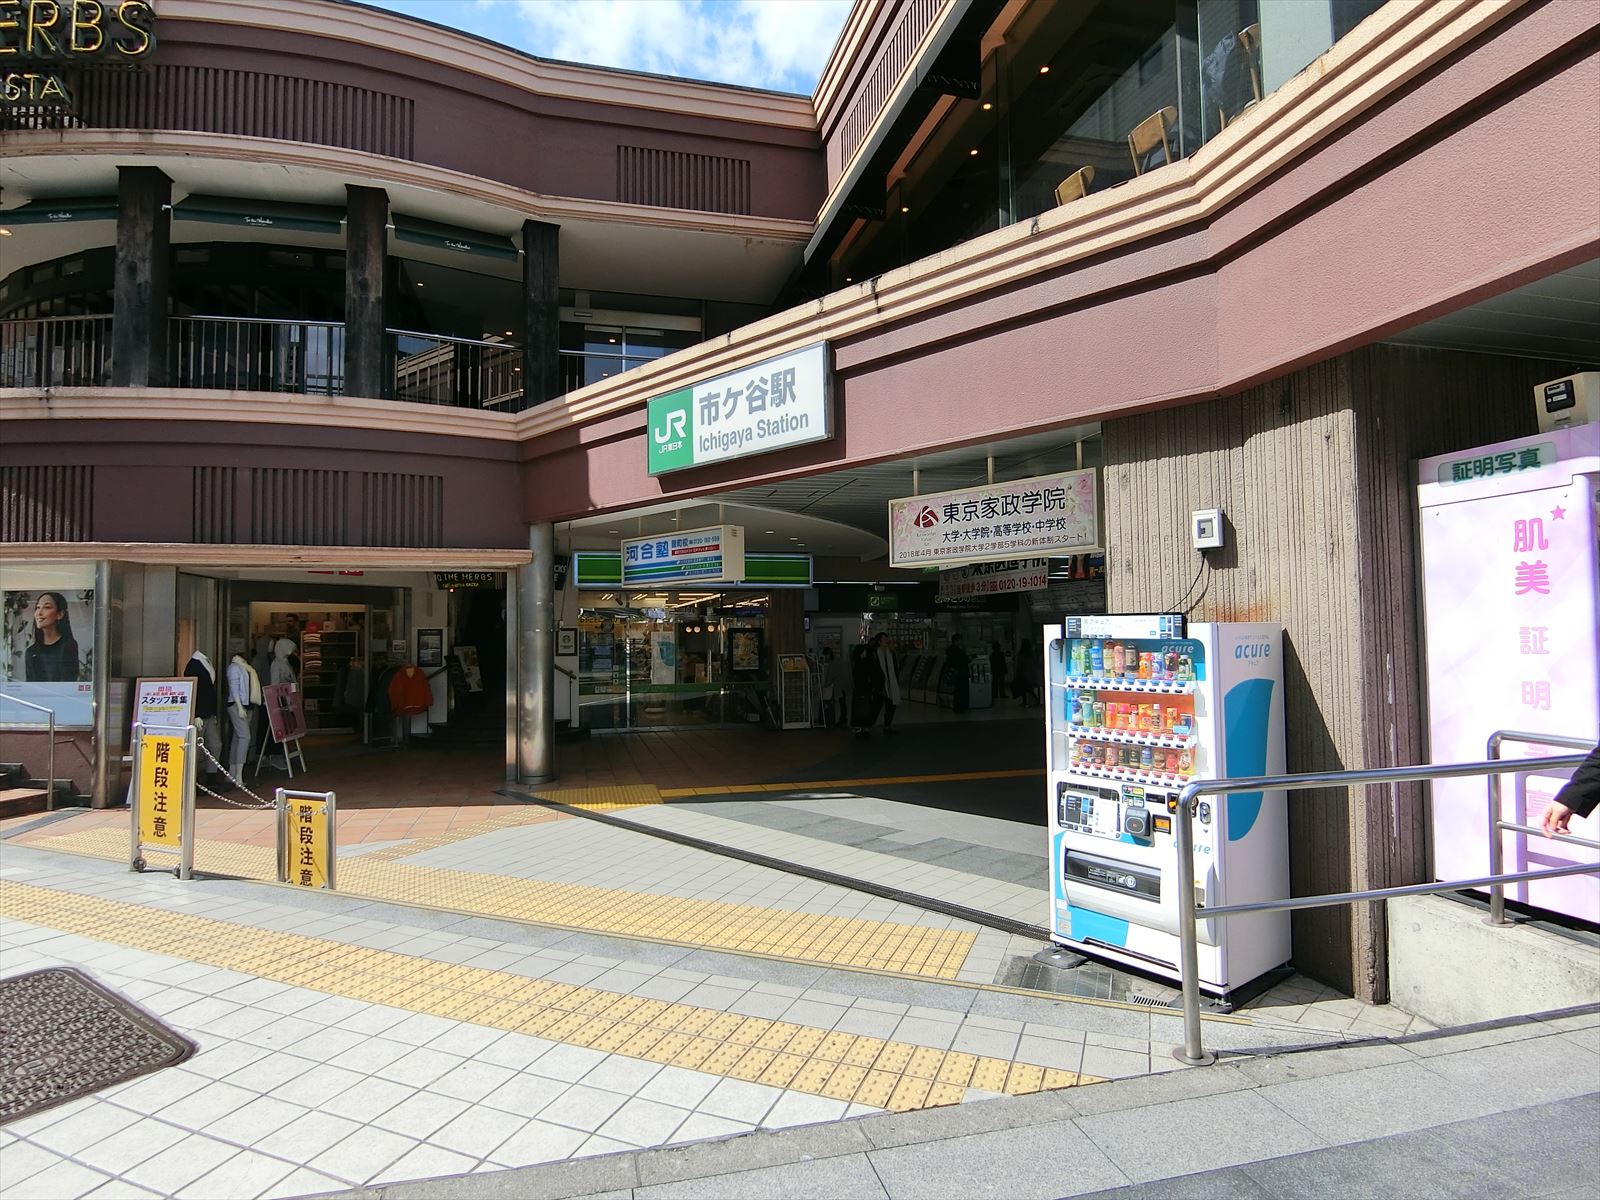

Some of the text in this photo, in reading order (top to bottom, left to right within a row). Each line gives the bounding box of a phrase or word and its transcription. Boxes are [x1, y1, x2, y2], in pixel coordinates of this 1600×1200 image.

[0, 73, 66, 101] STA
[654, 408, 687, 444] JR
[699, 412, 809, 453] Ichigaya Station
[1452, 448, 1541, 483] 証明写真
[942, 486, 1066, 525] 東京家政学院
[626, 540, 669, 562] 河合塾
[899, 548, 932, 559] 2018年4月
[1513, 517, 1551, 595] 肌美
[444, 573, 459, 582] THE
[461, 573, 493, 581] HERBS
[998, 575, 1047, 591] 0120-19-1014
[1161, 644, 1194, 653] acure
[1235, 643, 1270, 659] acure
[141, 695, 188, 705] スタッフ募集
[152, 741, 170, 838] 階段注意
[299, 805, 314, 887] 階段注意
